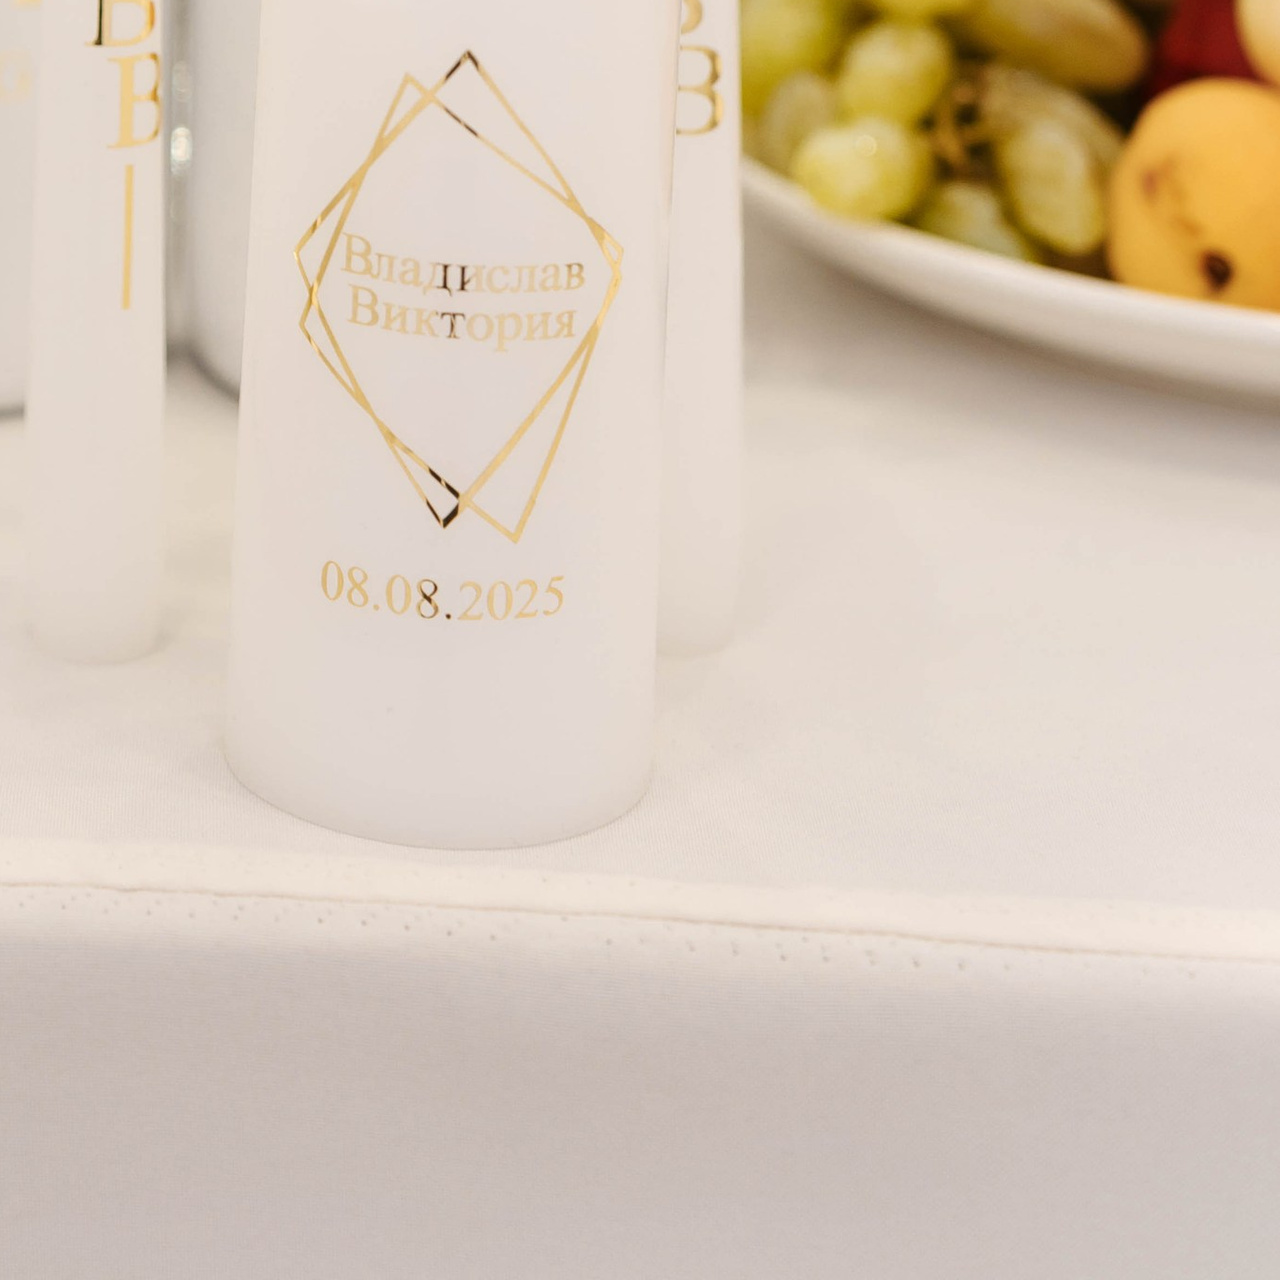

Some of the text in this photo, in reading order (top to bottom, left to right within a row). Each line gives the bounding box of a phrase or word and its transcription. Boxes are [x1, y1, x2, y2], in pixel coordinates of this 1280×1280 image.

[340, 232, 586, 297] Владислав
[346, 283, 578, 353] Виктория
[320, 560, 565, 621] 08.08.2025
